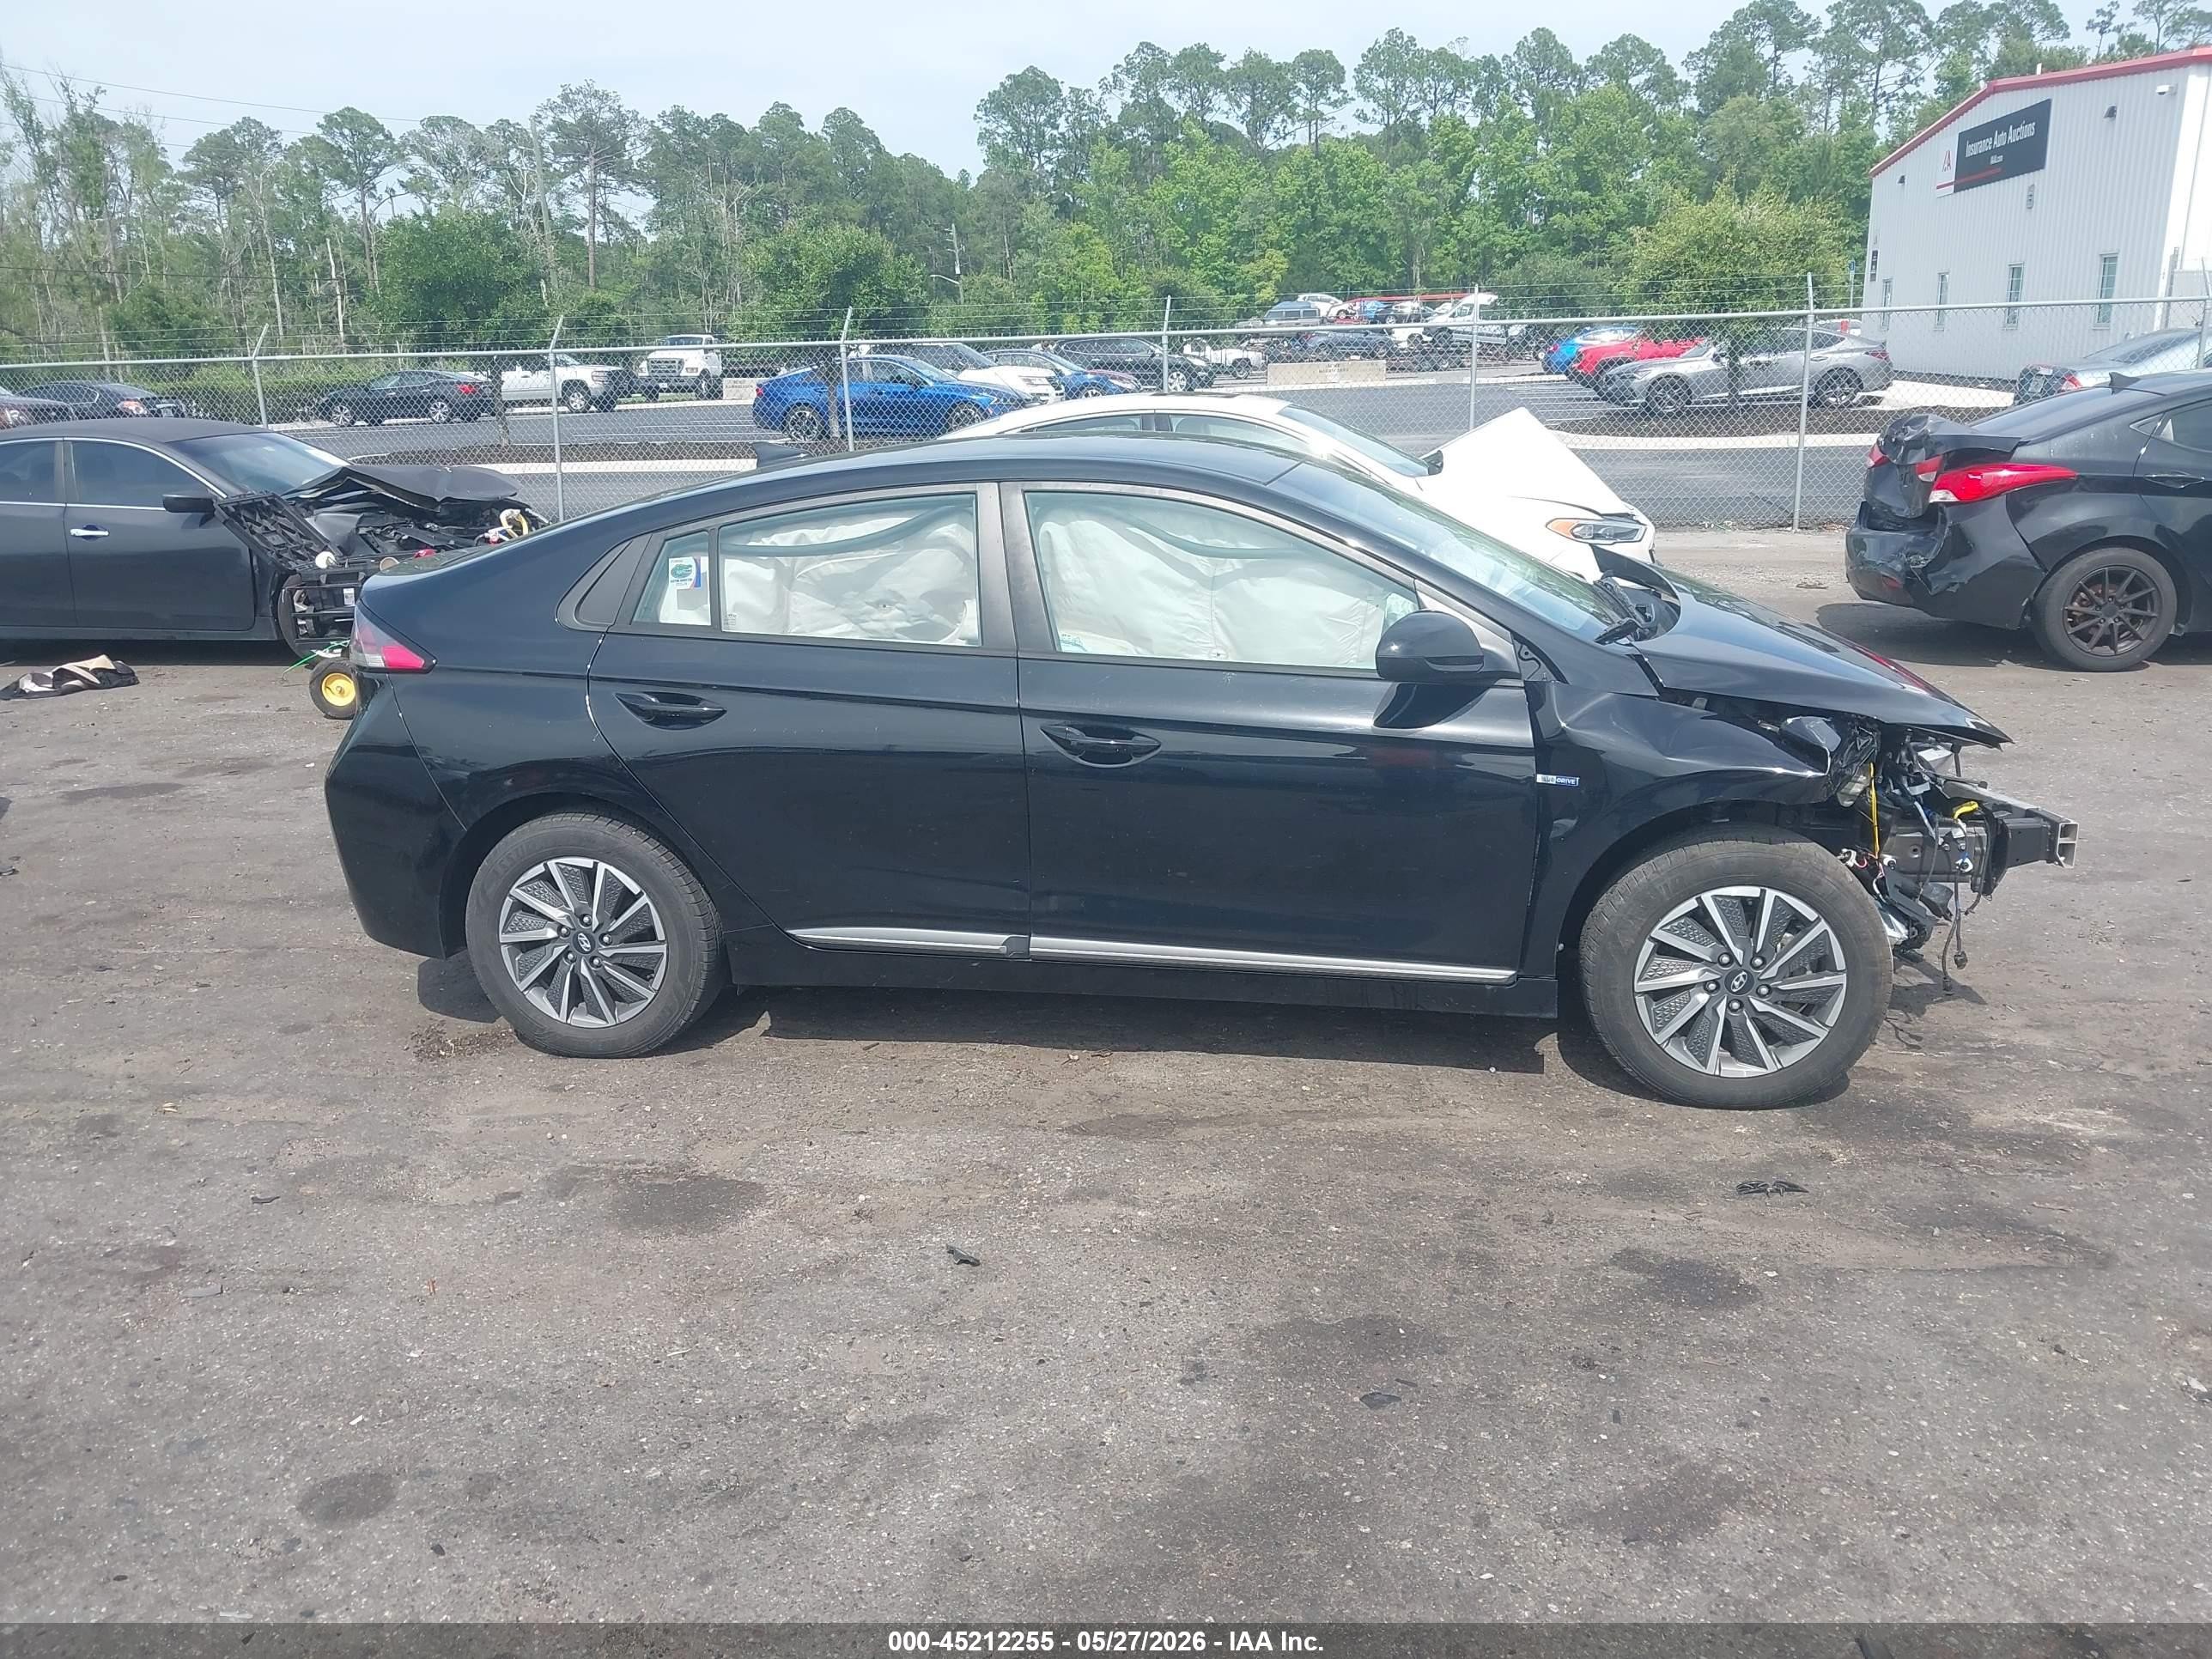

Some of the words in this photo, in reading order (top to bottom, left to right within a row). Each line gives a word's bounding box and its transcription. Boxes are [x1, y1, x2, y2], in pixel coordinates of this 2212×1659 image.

[1966, 137, 1992, 157] Insurance
[1993, 130, 2007, 149] Auto
[2008, 120, 2036, 144] Auctions
